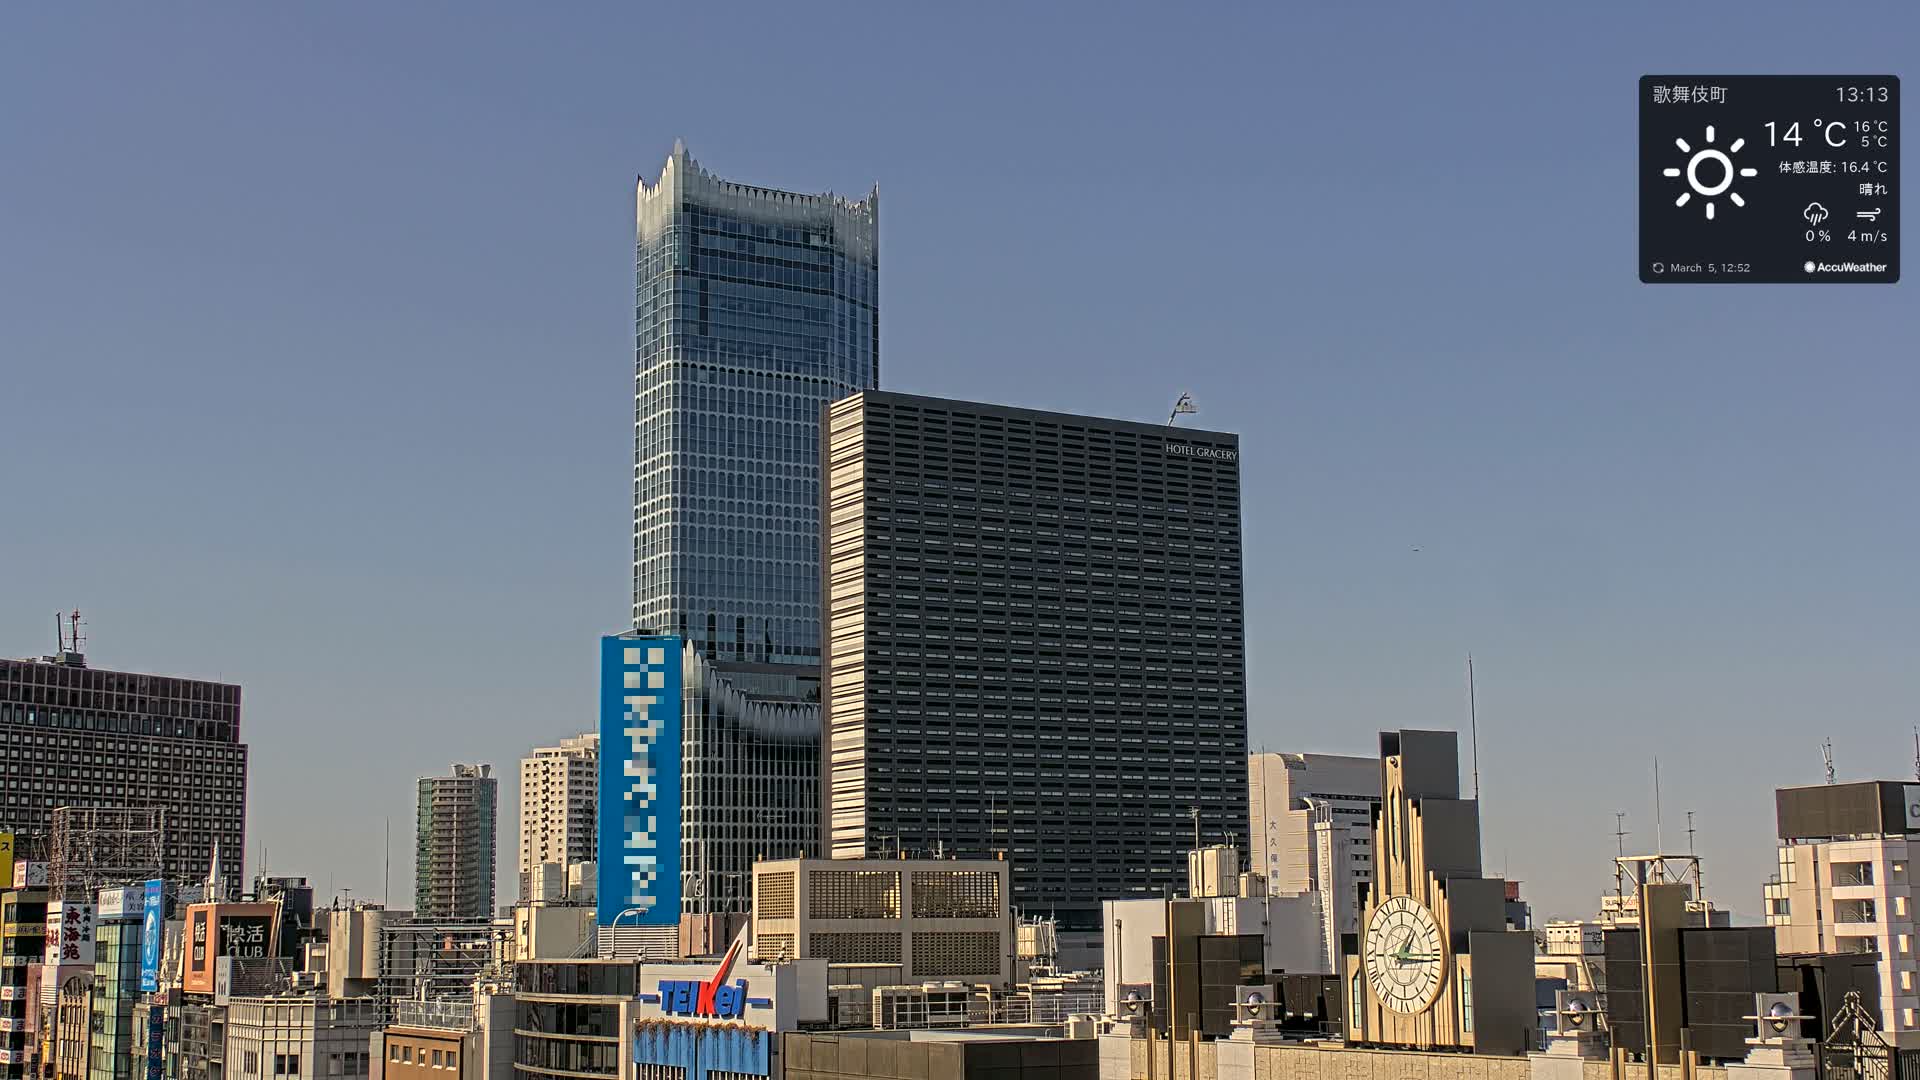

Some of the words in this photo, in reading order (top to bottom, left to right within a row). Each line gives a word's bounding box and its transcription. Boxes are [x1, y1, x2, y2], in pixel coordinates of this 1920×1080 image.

[1166, 443, 1195, 456] HOTEL
[1196, 447, 1237, 460] GRACERY
[63, 906, 81, 960] 東海苑
[228, 924, 264, 943] 快活
[228, 945, 263, 958] CLUB
